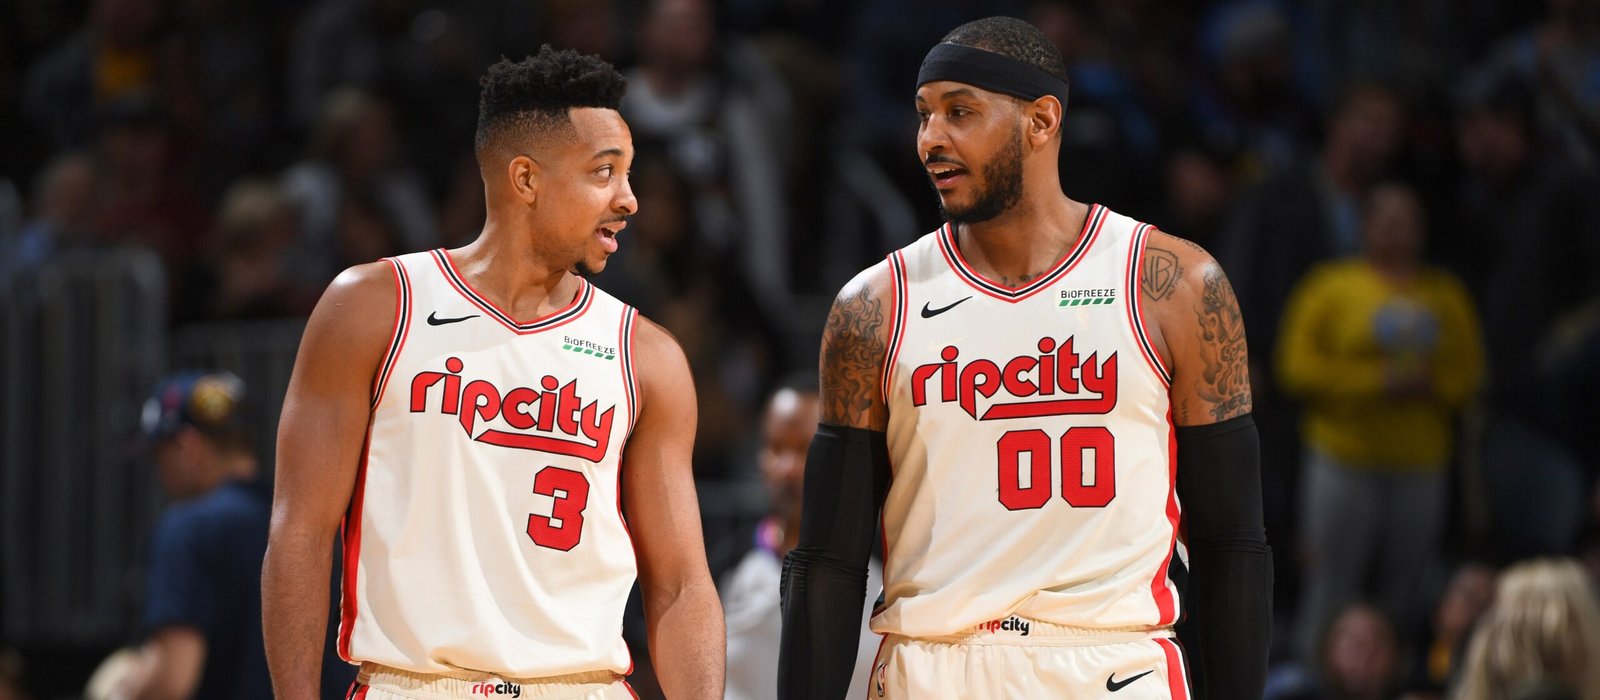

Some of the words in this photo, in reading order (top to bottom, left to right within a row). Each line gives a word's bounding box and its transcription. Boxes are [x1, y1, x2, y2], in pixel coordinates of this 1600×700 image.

[409, 356, 617, 464] ripcity
[910, 334, 1118, 422] ripcity
[526, 465, 591, 553] 3
[996, 426, 1117, 512] 00
